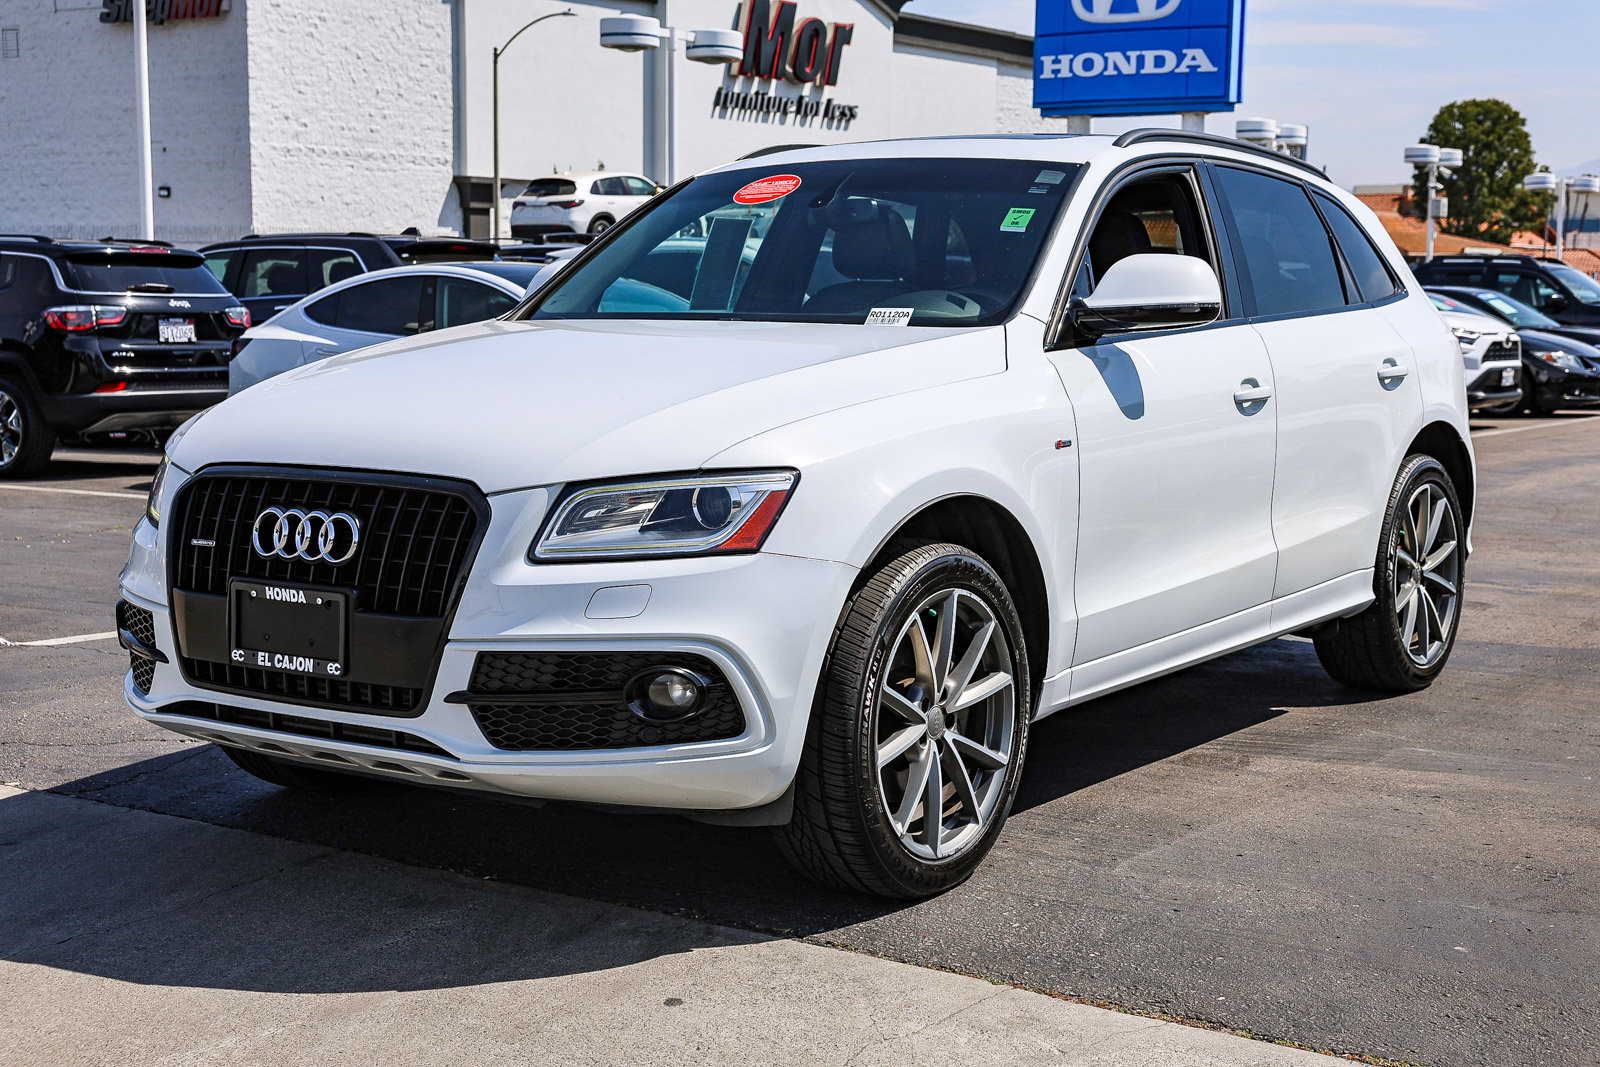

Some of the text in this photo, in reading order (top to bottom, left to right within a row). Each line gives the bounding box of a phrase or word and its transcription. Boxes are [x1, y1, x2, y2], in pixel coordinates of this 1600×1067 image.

[736, 0, 855, 86] Mor
[1039, 48, 1218, 79] HONDA
[714, 86, 859, 121] furniture for less
[168, 298, 191, 308] Jeep
[265, 586, 307, 604] HONDA
[257, 651, 314, 673] EL CAJON
